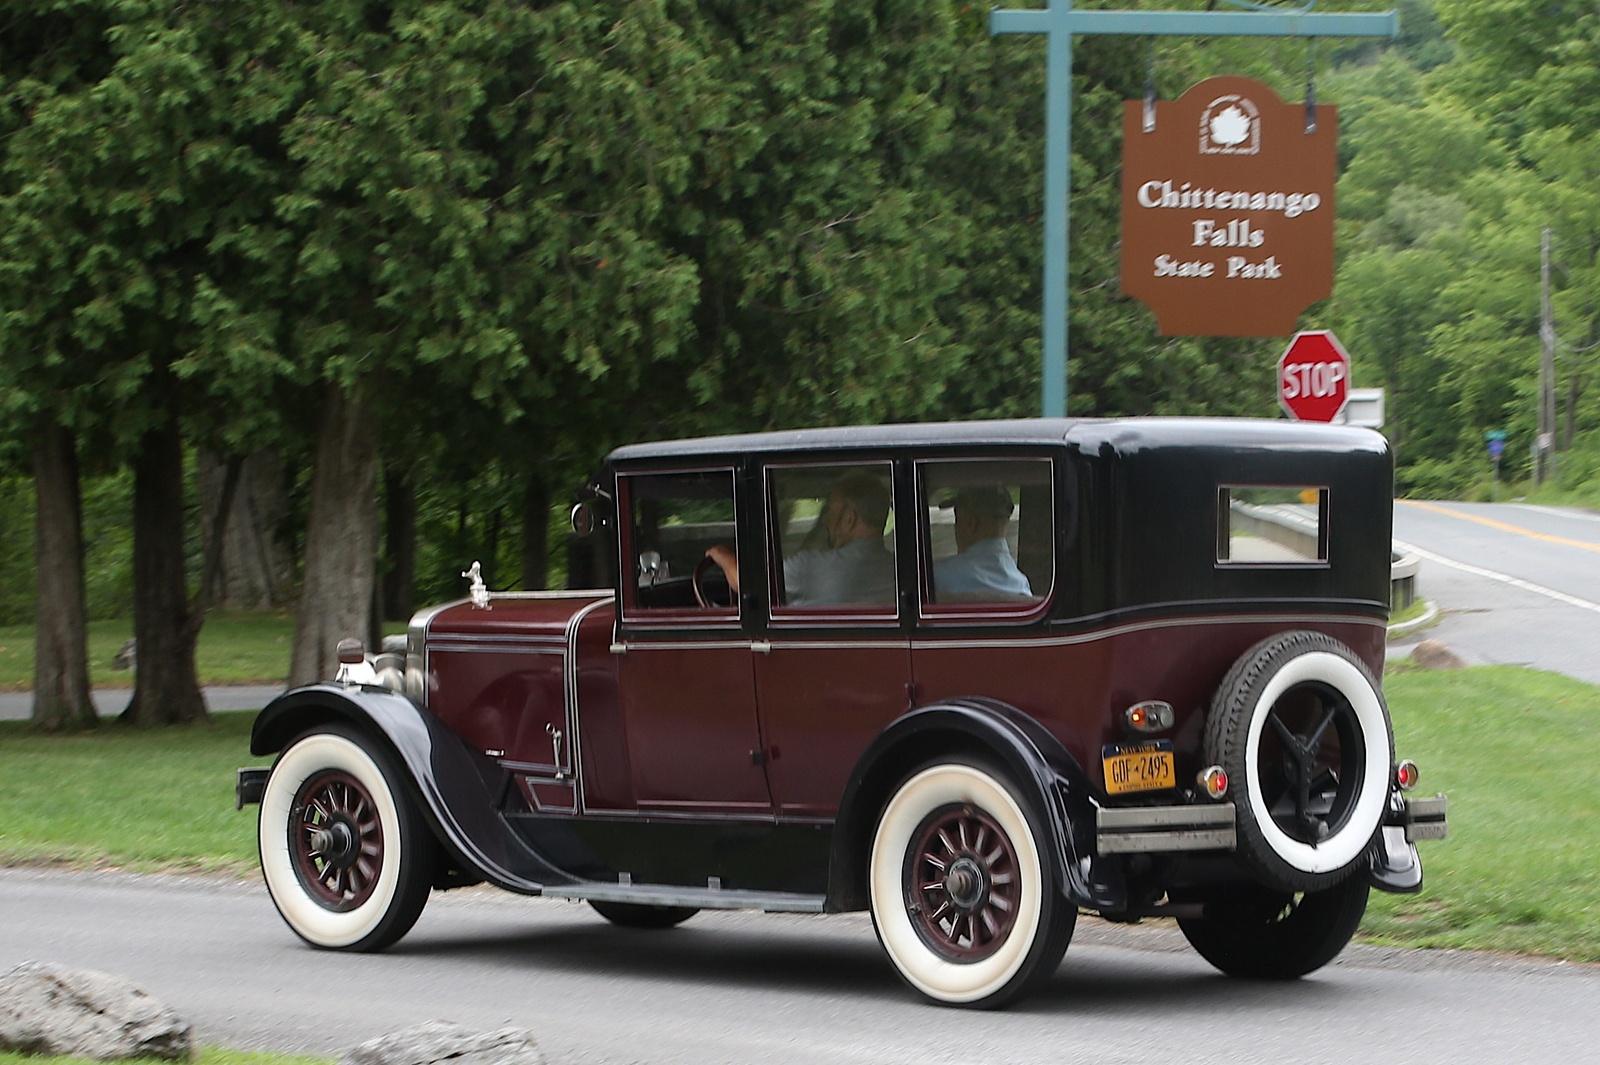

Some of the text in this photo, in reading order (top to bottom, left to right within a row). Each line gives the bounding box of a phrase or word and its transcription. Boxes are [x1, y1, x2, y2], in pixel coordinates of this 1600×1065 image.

[1137, 179, 1321, 218] Chittenango
[1191, 219, 1265, 248] Falls
[1153, 253, 1282, 279] State Park
[1283, 361, 1346, 399] STOP
